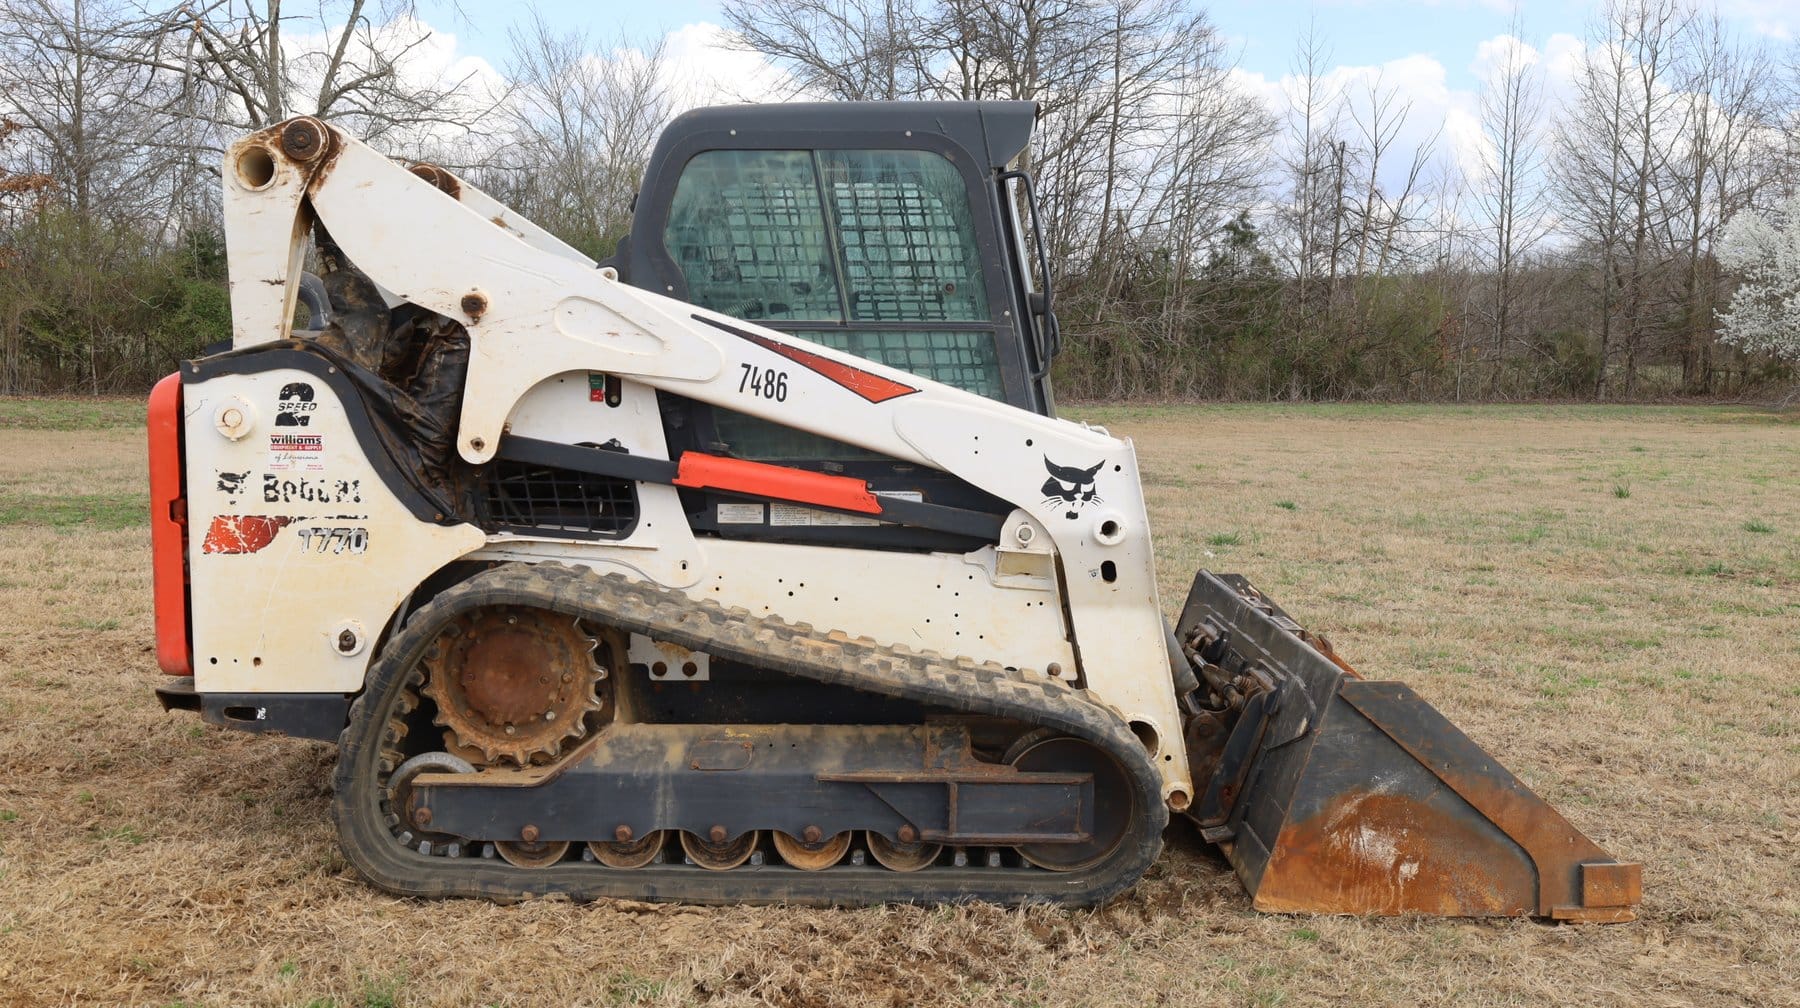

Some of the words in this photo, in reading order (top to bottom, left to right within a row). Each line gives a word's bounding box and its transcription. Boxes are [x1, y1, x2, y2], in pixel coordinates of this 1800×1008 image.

[739, 363, 788, 402] 7486
[275, 382, 315, 427] 2
[278, 402, 317, 412] SPEED
[271, 435, 322, 445] williams
[298, 528, 369, 555] T770
